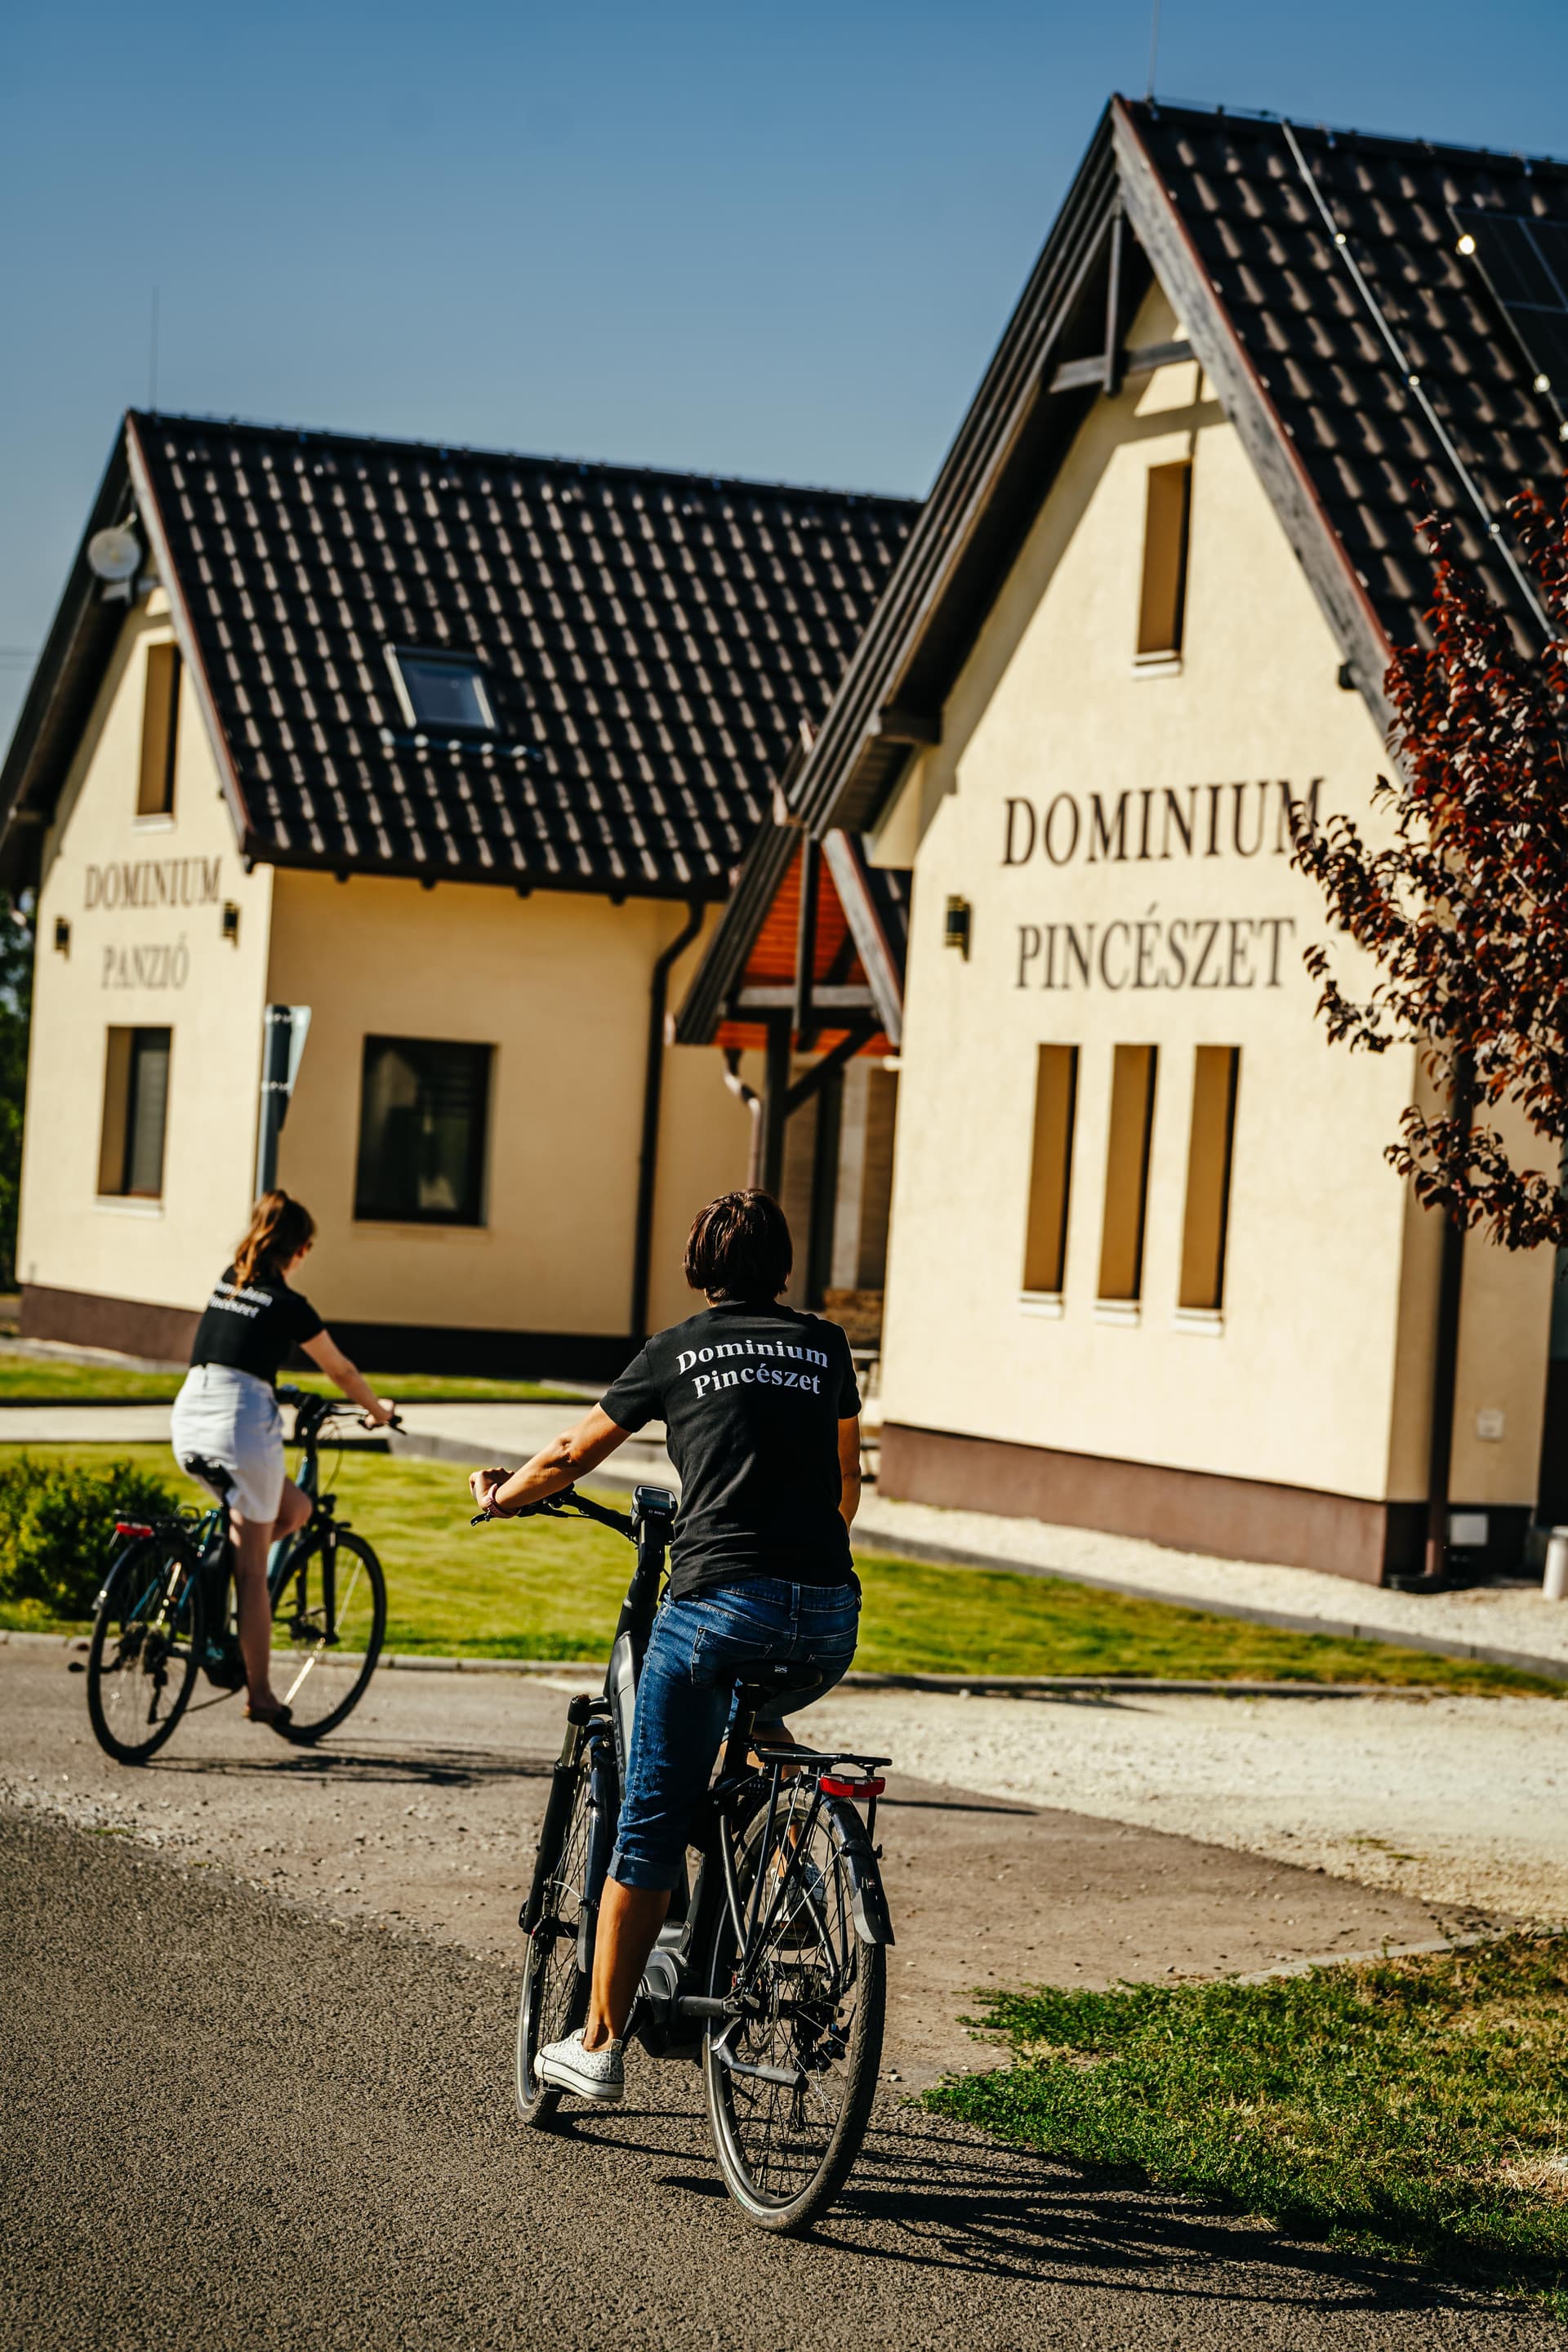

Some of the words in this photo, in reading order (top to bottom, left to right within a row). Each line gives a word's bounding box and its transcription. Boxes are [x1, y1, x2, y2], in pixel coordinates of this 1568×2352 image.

[1001, 777, 1325, 866] DOMINIUM
[84, 854, 222, 911] DOMINIUM
[100, 931, 190, 990] PANZIÓ
[1014, 902, 1296, 990] PINCÉSZET
[675, 1339, 829, 1375] Dominium
[692, 1363, 821, 1400] Pincészet
